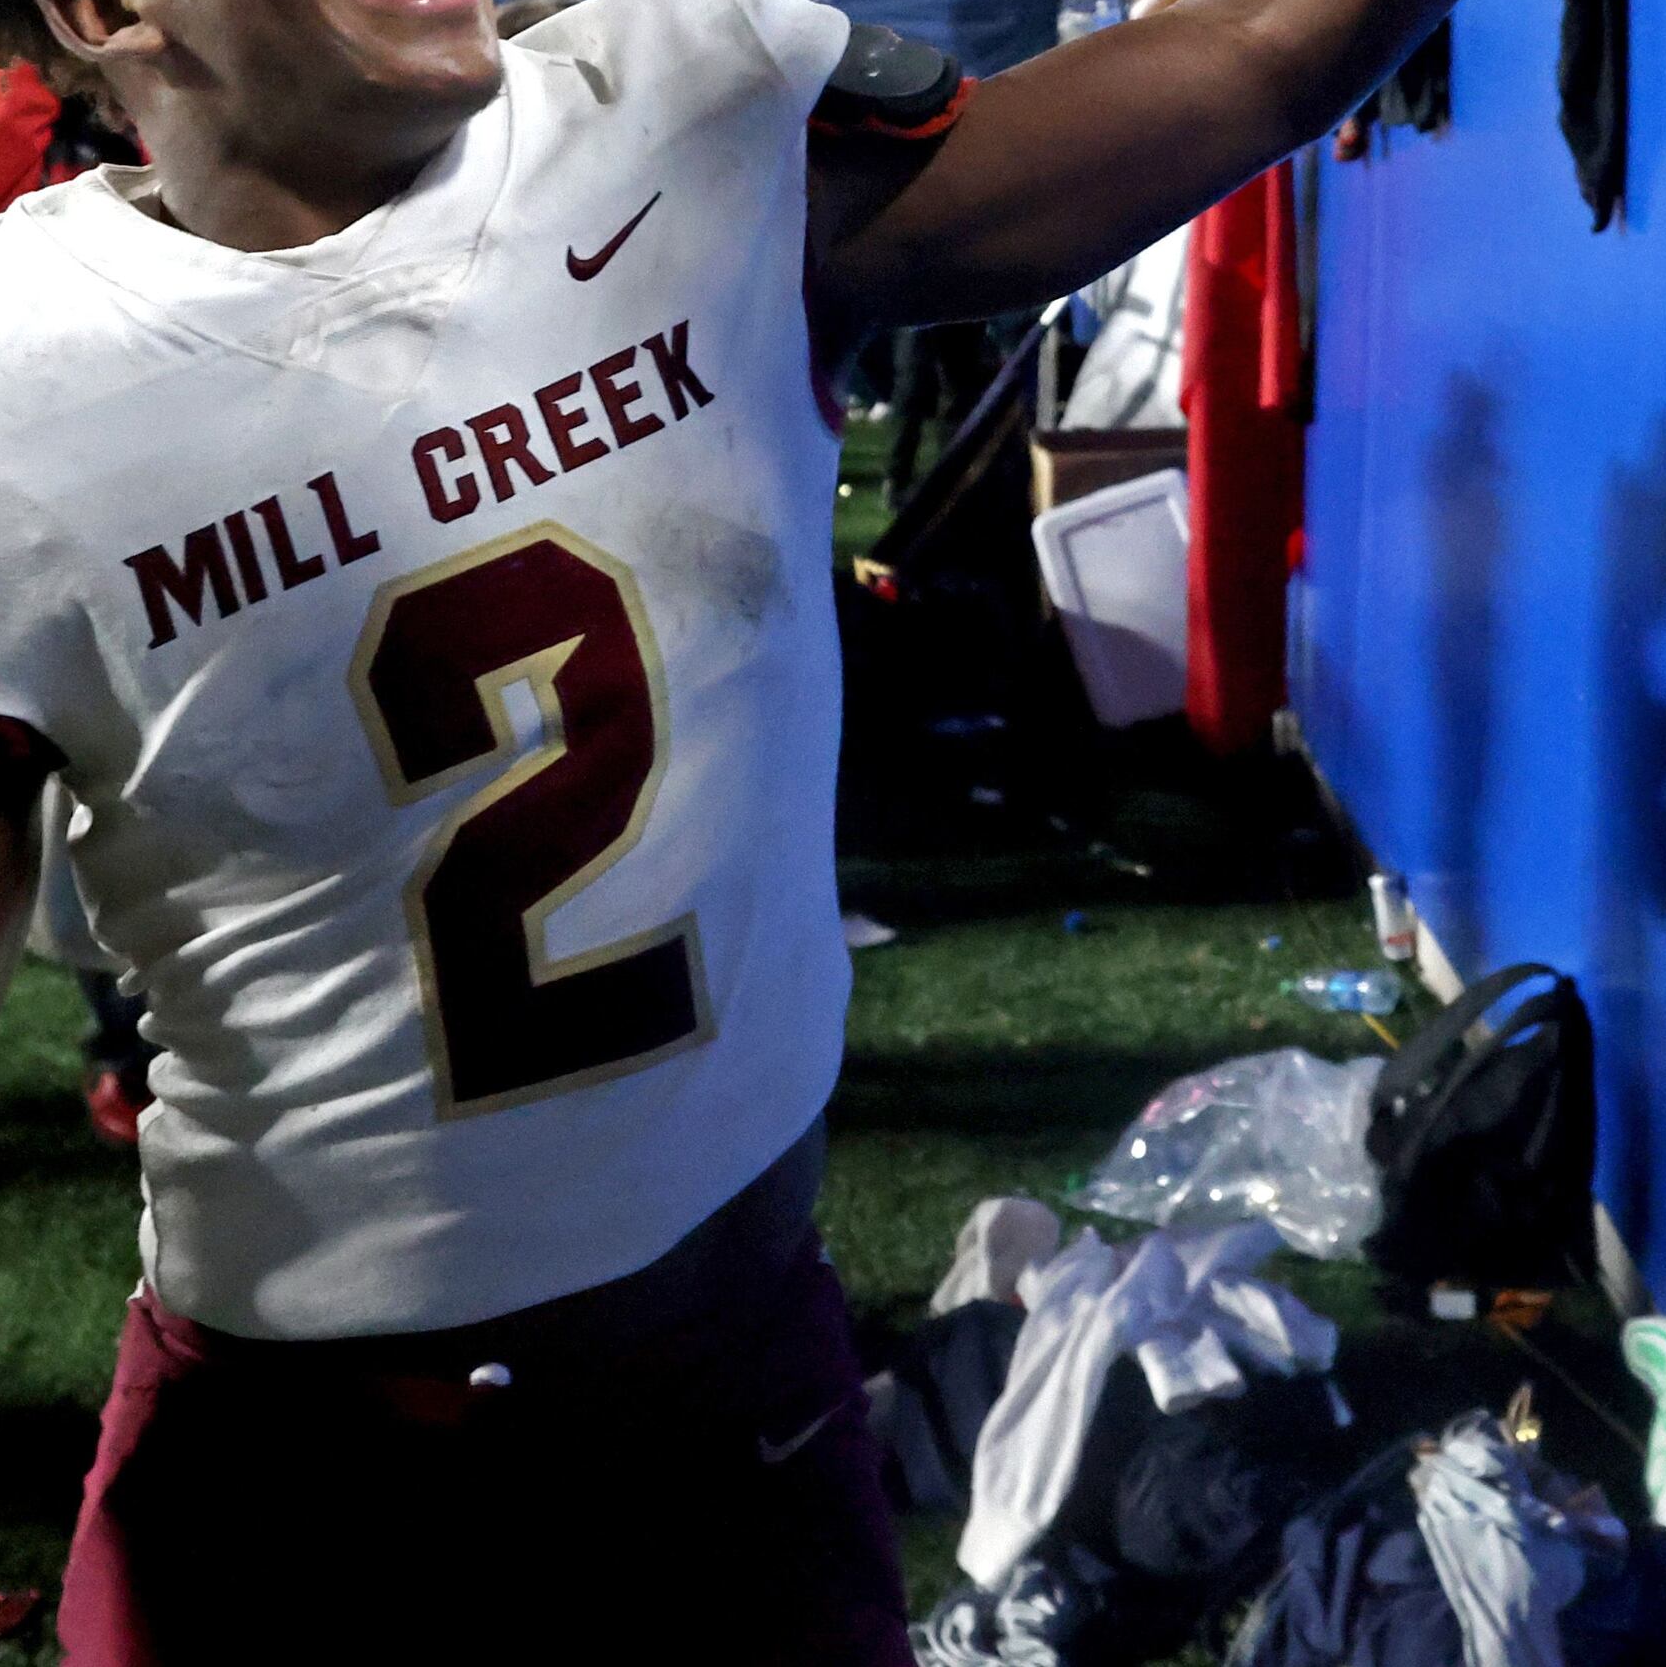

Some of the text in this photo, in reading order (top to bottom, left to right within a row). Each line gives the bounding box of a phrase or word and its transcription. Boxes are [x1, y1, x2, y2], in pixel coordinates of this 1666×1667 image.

[124, 319, 715, 649] MILL CREEK
[348, 519, 720, 1122] 2
